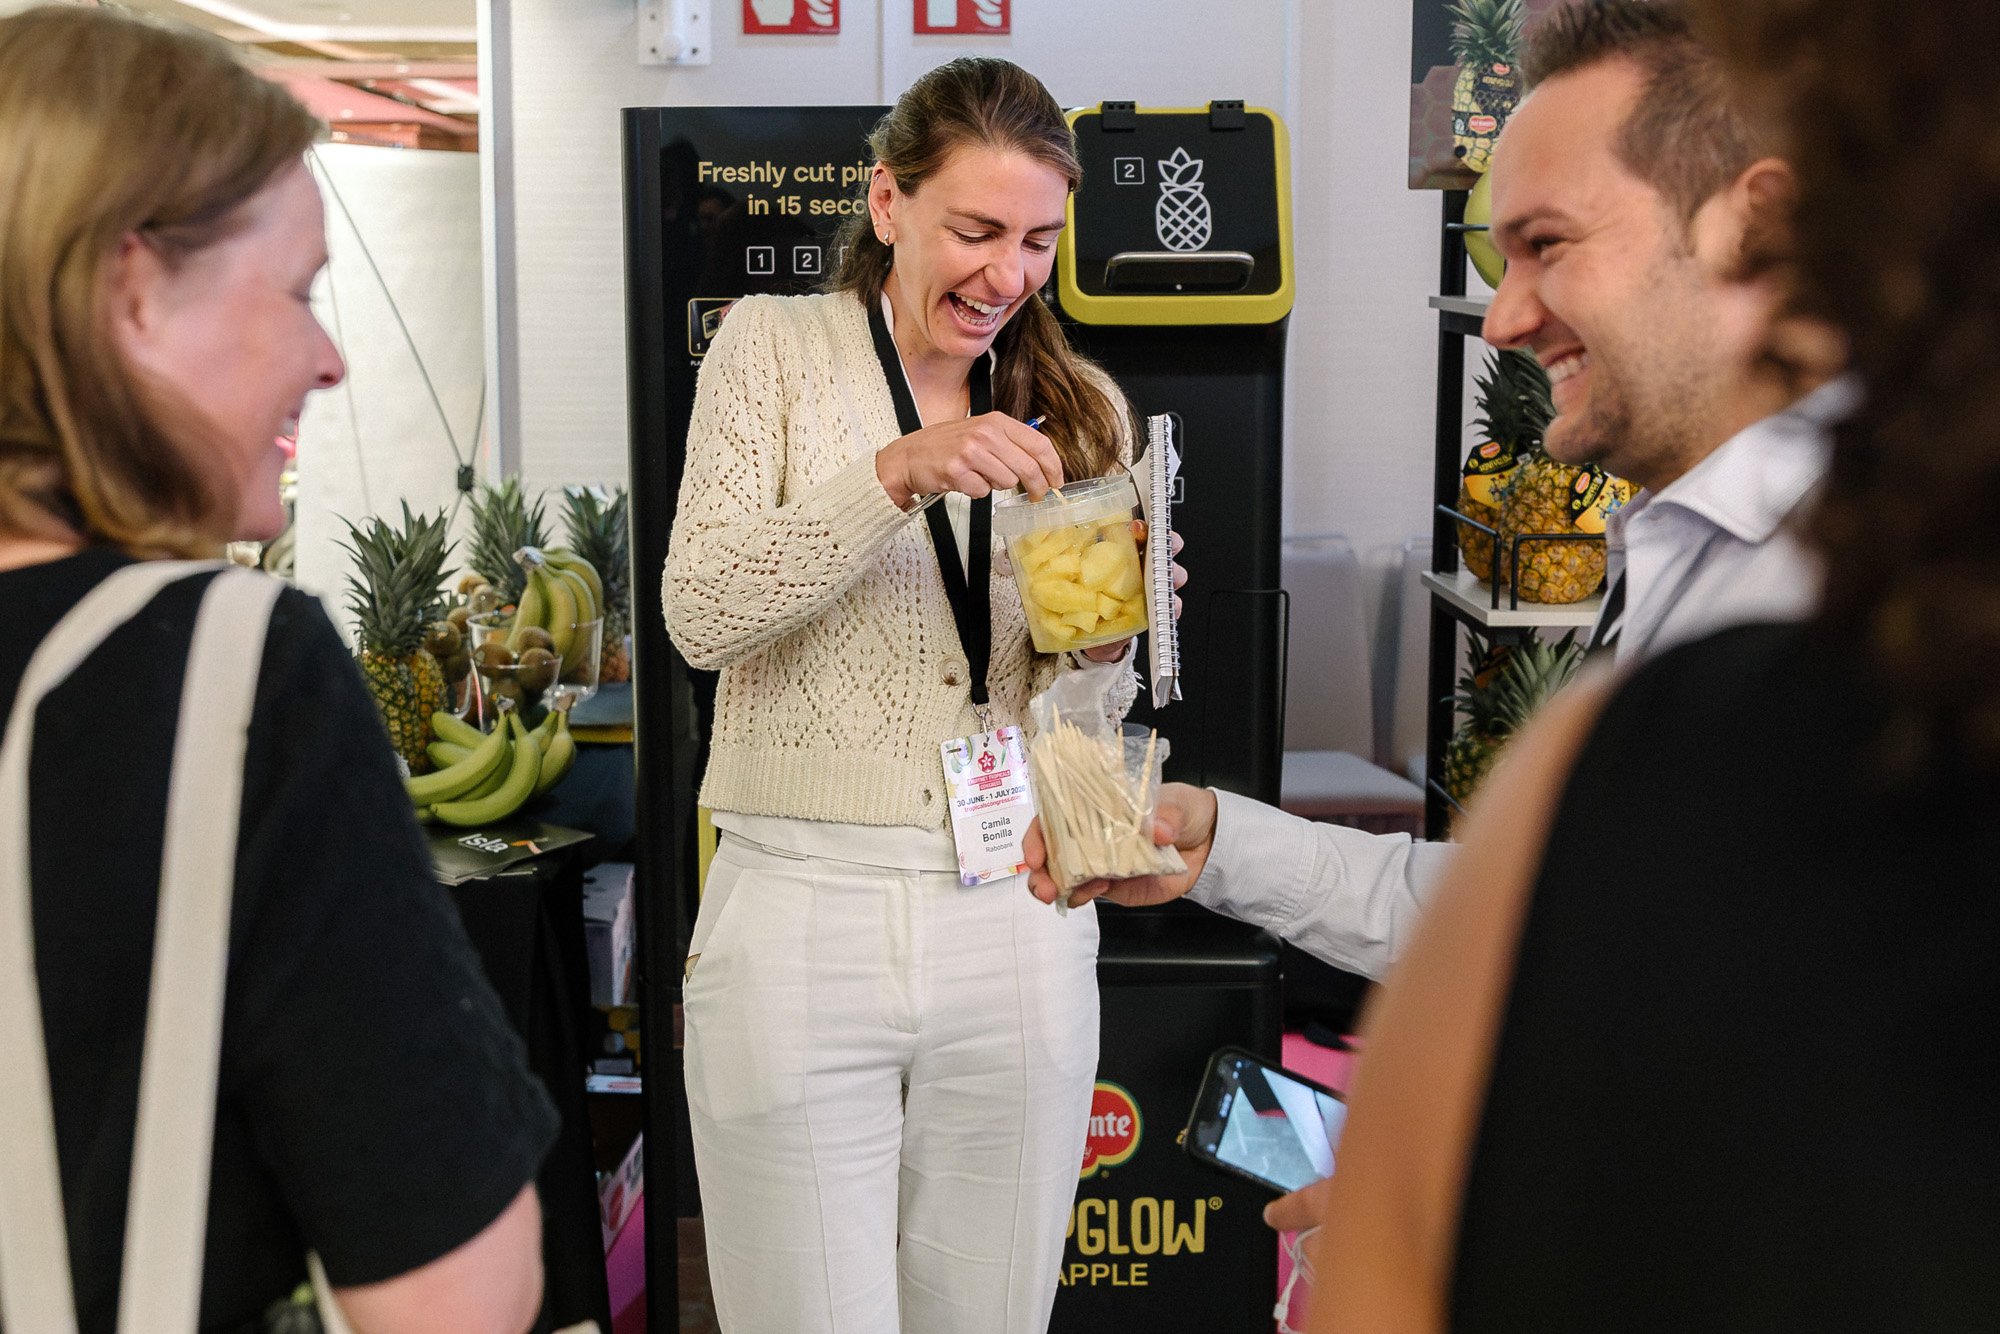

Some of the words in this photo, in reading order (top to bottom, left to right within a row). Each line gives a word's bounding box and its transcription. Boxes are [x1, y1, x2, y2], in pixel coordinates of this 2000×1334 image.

[698, 161, 787, 188] Freshly
[793, 163, 835, 183] cut
[1124, 163, 1135, 178] 2
[748, 194, 770, 215] in
[777, 195, 802, 215] 15
[757, 253, 764, 268] 1
[802, 253, 813, 268] 2
[957, 799, 966, 807] 30
[967, 794, 985, 806] JUNE
[995, 788, 1010, 799] JULY
[981, 817, 1011, 830] Camila
[458, 833, 509, 853] Isla
[983, 829, 1013, 842] Bonilla
[985, 841, 1014, 853] Rabobank
